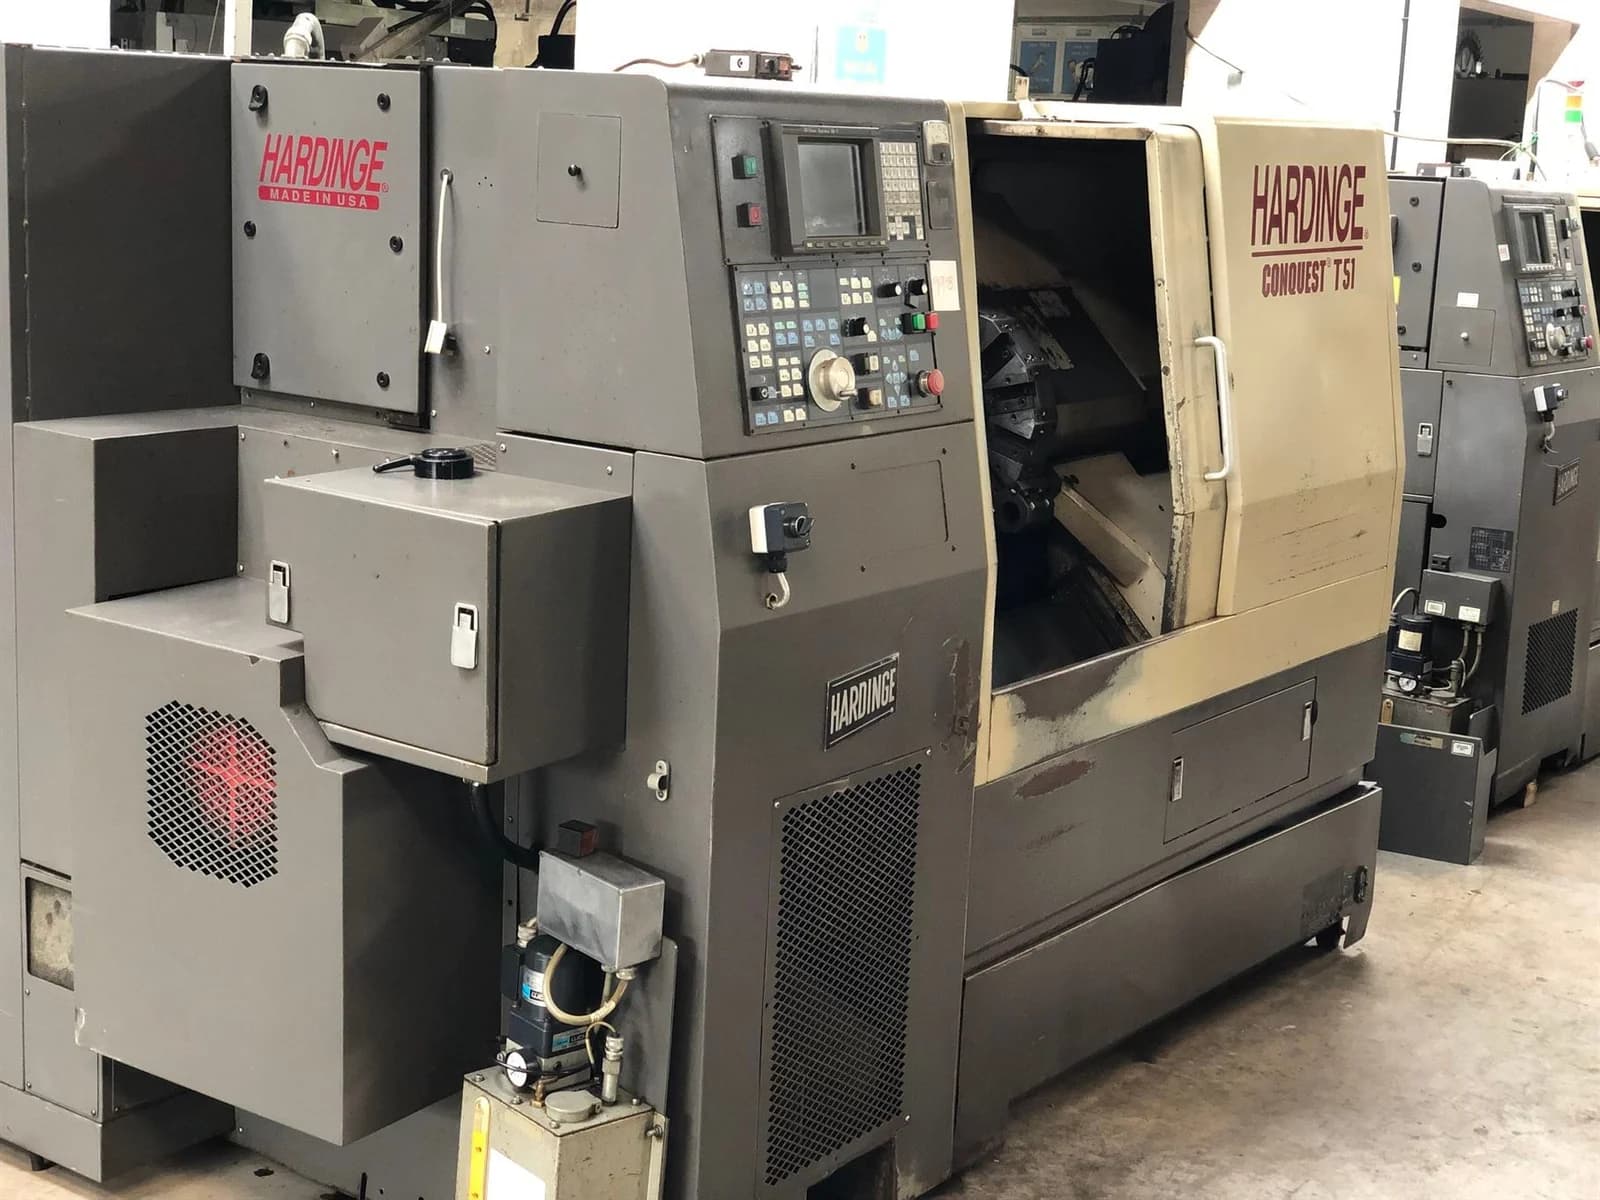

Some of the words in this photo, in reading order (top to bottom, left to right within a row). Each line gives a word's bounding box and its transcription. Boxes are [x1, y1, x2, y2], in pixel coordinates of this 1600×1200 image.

[259, 133, 388, 193] HARDINGE
[269, 187, 311, 203] MADE
[315, 190, 331, 205] IN
[336, 193, 368, 208] USA
[1251, 163, 1366, 246] HARDINGE
[1261, 259, 1327, 298] CONQUEST
[830, 667, 896, 735] HARDINGE
